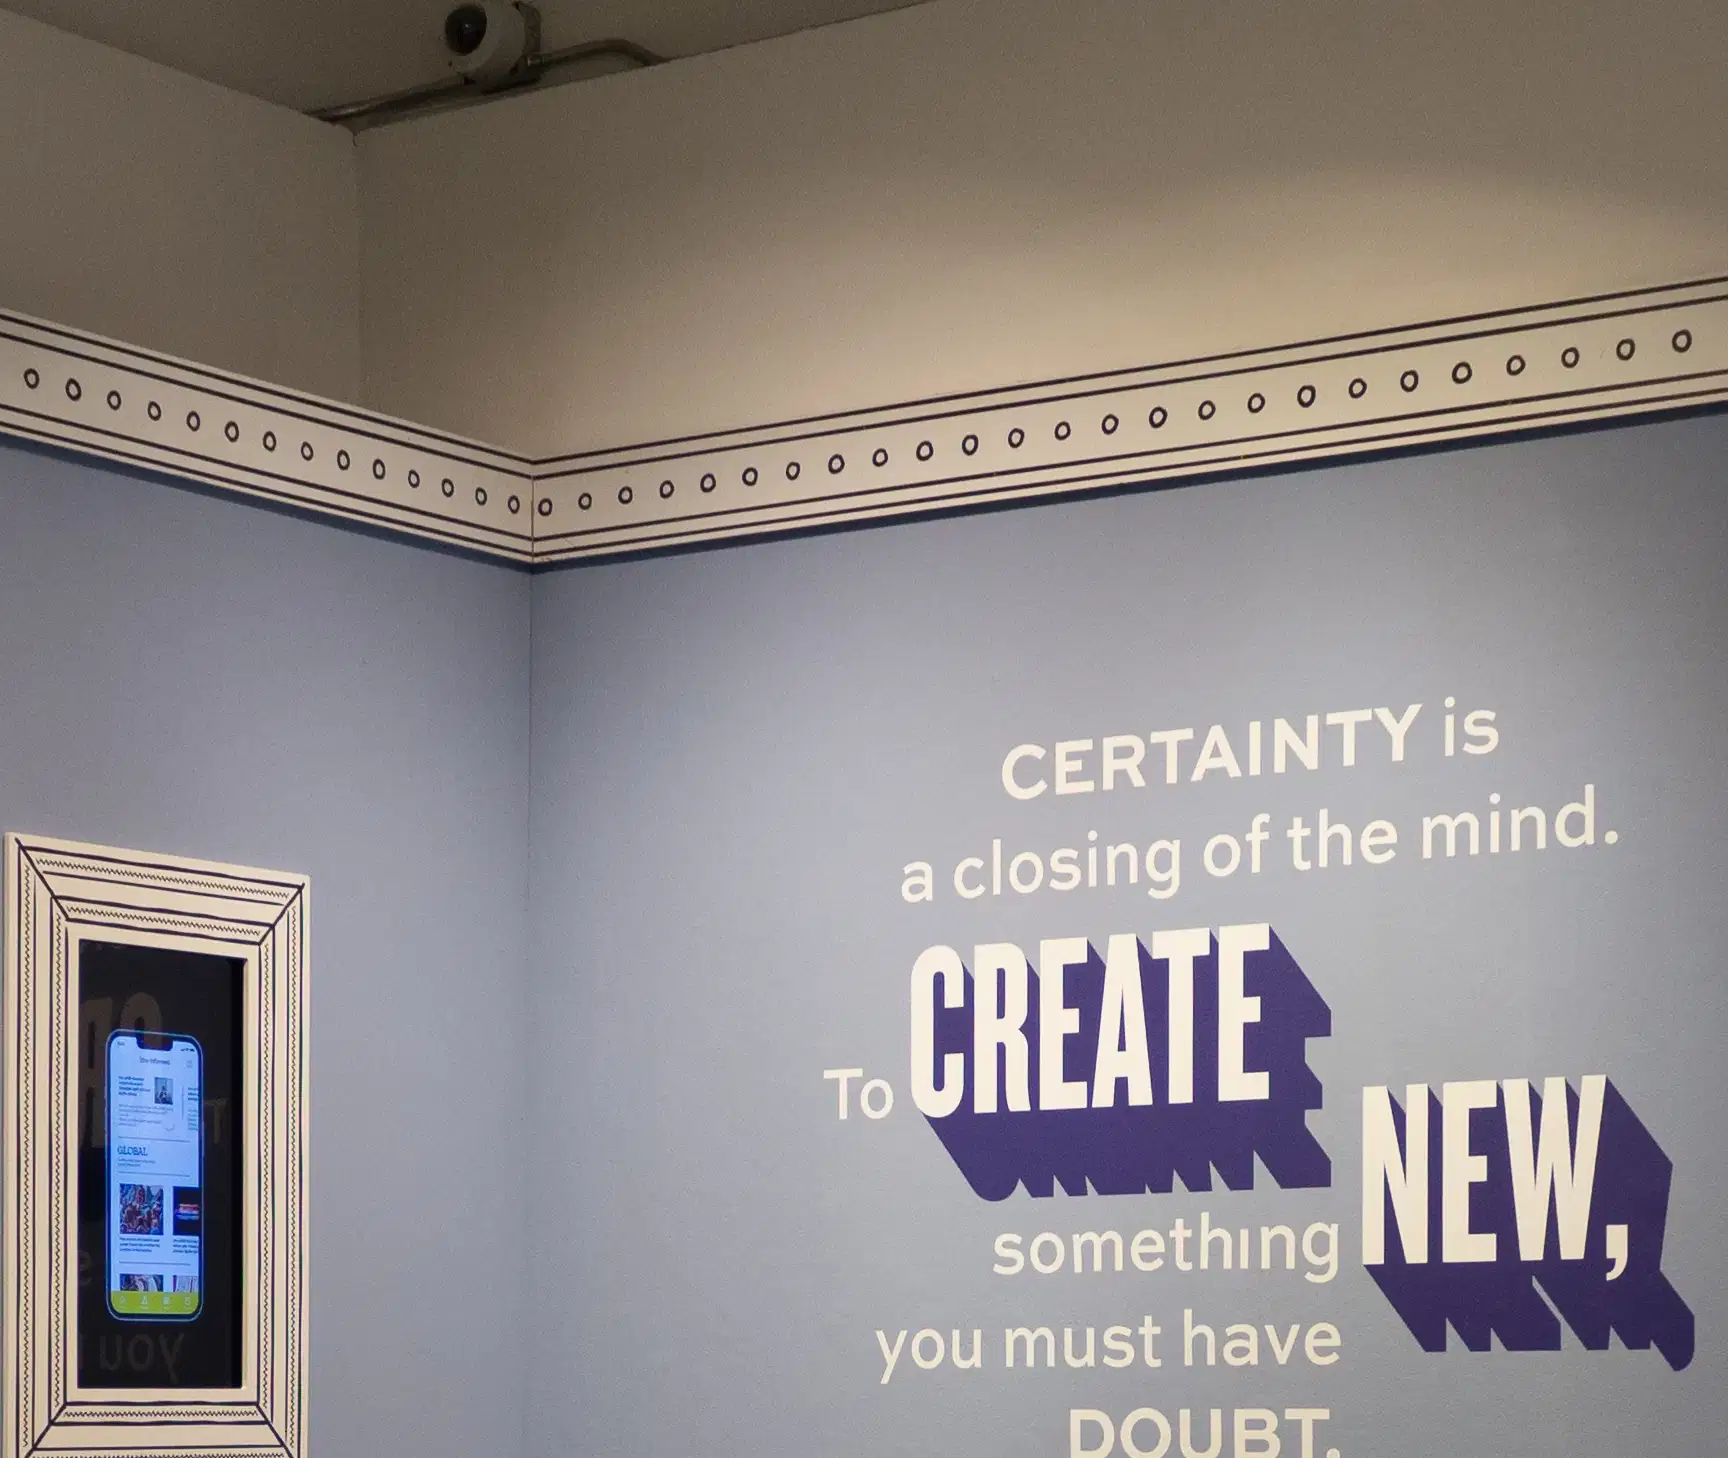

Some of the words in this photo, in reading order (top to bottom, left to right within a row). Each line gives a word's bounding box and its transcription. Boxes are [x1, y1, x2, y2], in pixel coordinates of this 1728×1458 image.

[1002, 704, 1422, 800] CERTAINTY
[1445, 697, 1499, 756] is
[902, 862, 932, 903] a
[954, 832, 1180, 899] closing
[1204, 814, 1270, 876] of
[1287, 808, 1397, 870] the
[1422, 784, 1618, 859] mind.
[824, 1068, 893, 1119] To
[910, 922, 1271, 1120] CREATE
[117, 1145, 148, 1157] GLOBAL
[993, 1212, 1338, 1283] something
[1362, 1074, 1629, 1281] NEW,
[876, 1328, 981, 1384] you
[1005, 1316, 1161, 1368] must
[1184, 1309, 1341, 1366] have
